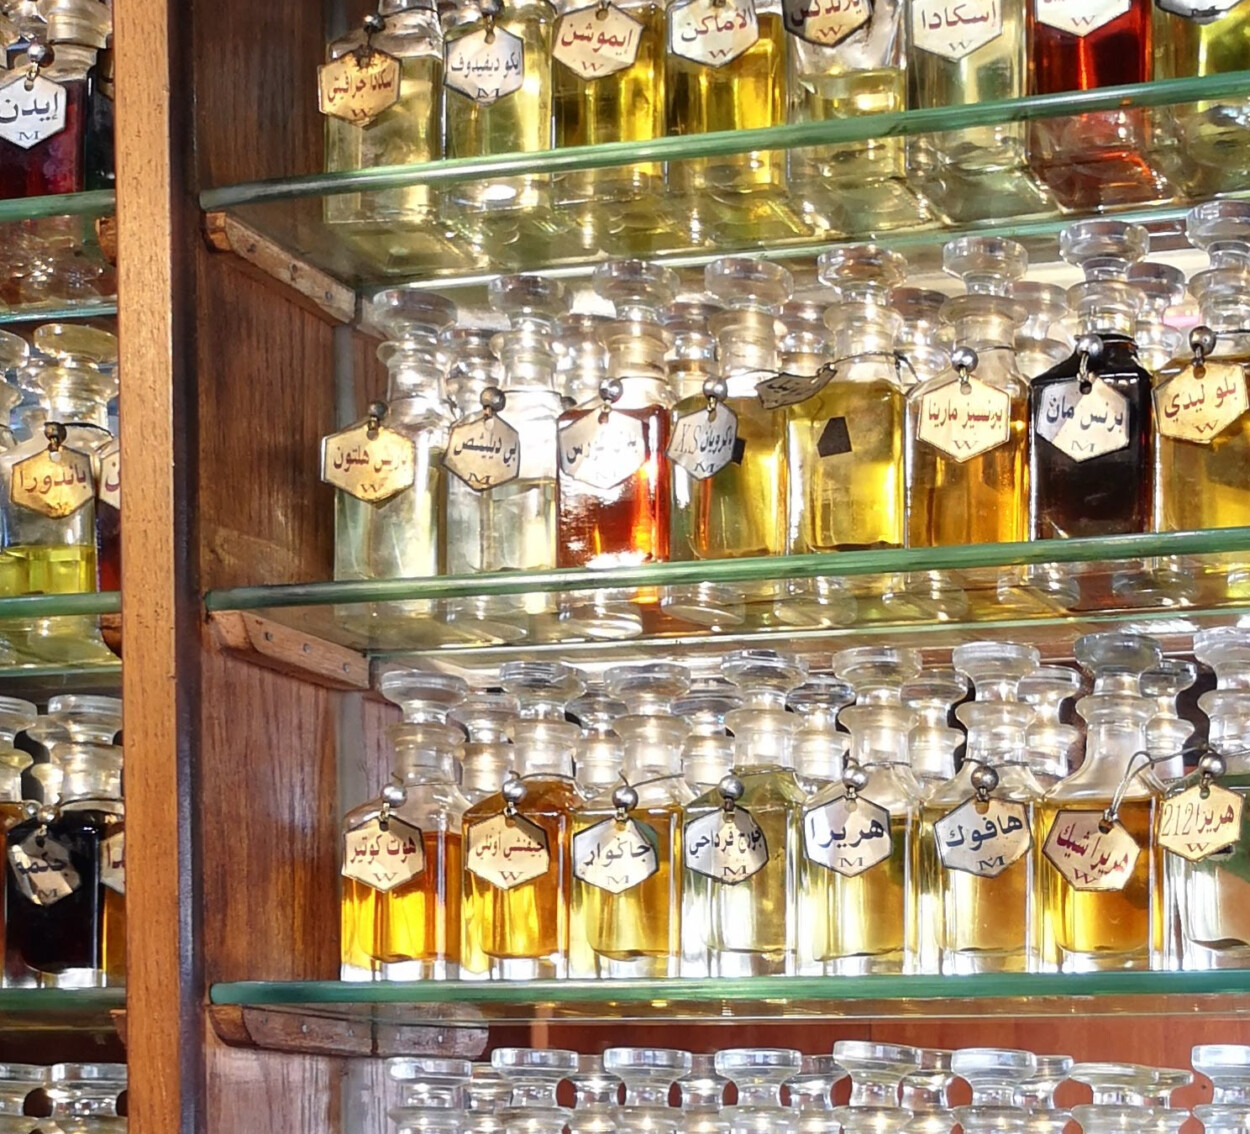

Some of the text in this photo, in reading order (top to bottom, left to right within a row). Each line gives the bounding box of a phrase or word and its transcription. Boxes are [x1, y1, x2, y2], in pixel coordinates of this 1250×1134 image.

[1070, 15, 1097, 28] W
[817, 25, 847, 38] W
[948, 40, 975, 52] W
[709, 48, 734, 59] W
[580, 61, 604, 73] W
[475, 88, 500, 99] M
[19, 131, 40, 141] M
[1164, 376, 1238, 423] بلو ليدي
[1047, 395, 1124, 434] برنس مان
[1194, 420, 1218, 434] W
[953, 440, 978, 451] W
[1071, 440, 1095, 453] M
[694, 462, 715, 473] M
[467, 473, 491, 485] M
[360, 484, 382, 494] W
[811, 818, 885, 849] هريرا
[945, 815, 1023, 851] هافوك
[386, 836, 417, 863] هوت
[1185, 842, 1210, 853] W
[840, 857, 863, 868] M
[978, 855, 1005, 871] M
[499, 870, 524, 881] W
[723, 865, 747, 876] M
[1073, 867, 1096, 884] W
[372, 872, 398, 882] W
[607, 875, 630, 885] M
